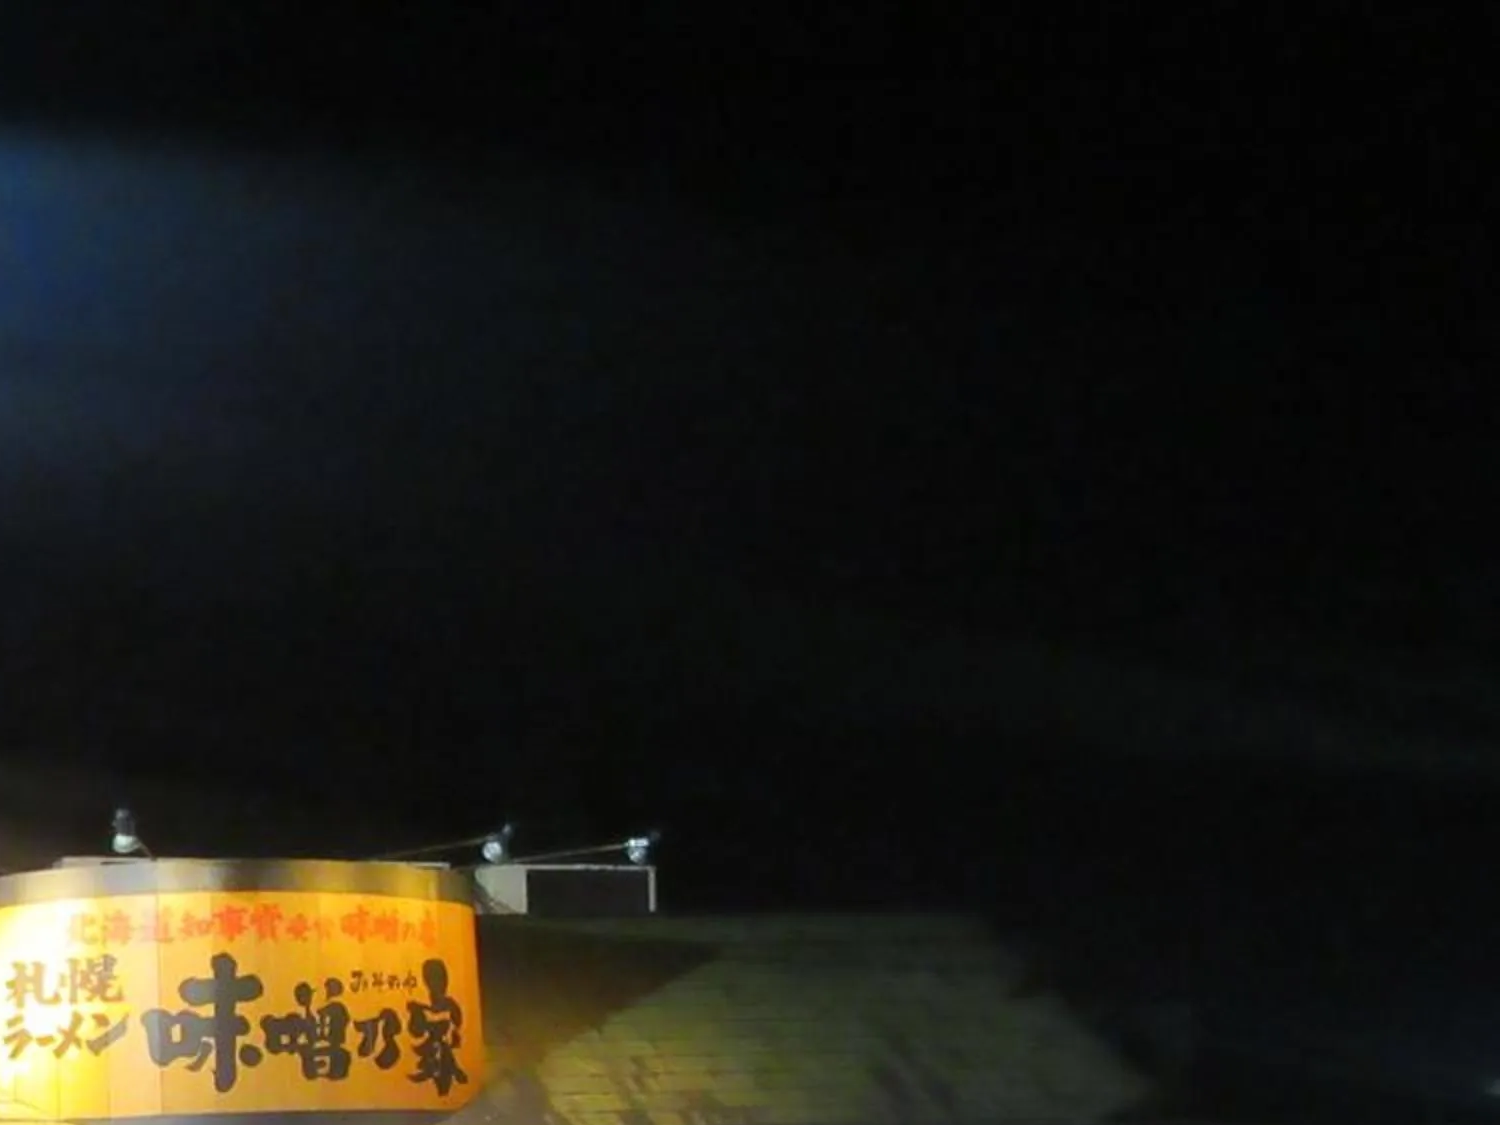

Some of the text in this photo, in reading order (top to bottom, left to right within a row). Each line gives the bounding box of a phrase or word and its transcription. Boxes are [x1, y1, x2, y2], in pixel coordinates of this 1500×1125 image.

[4, 953, 126, 1008] 札幌
[2, 1010, 130, 1060] ラーメン
[140, 953, 468, 1096] 味噌乃家
